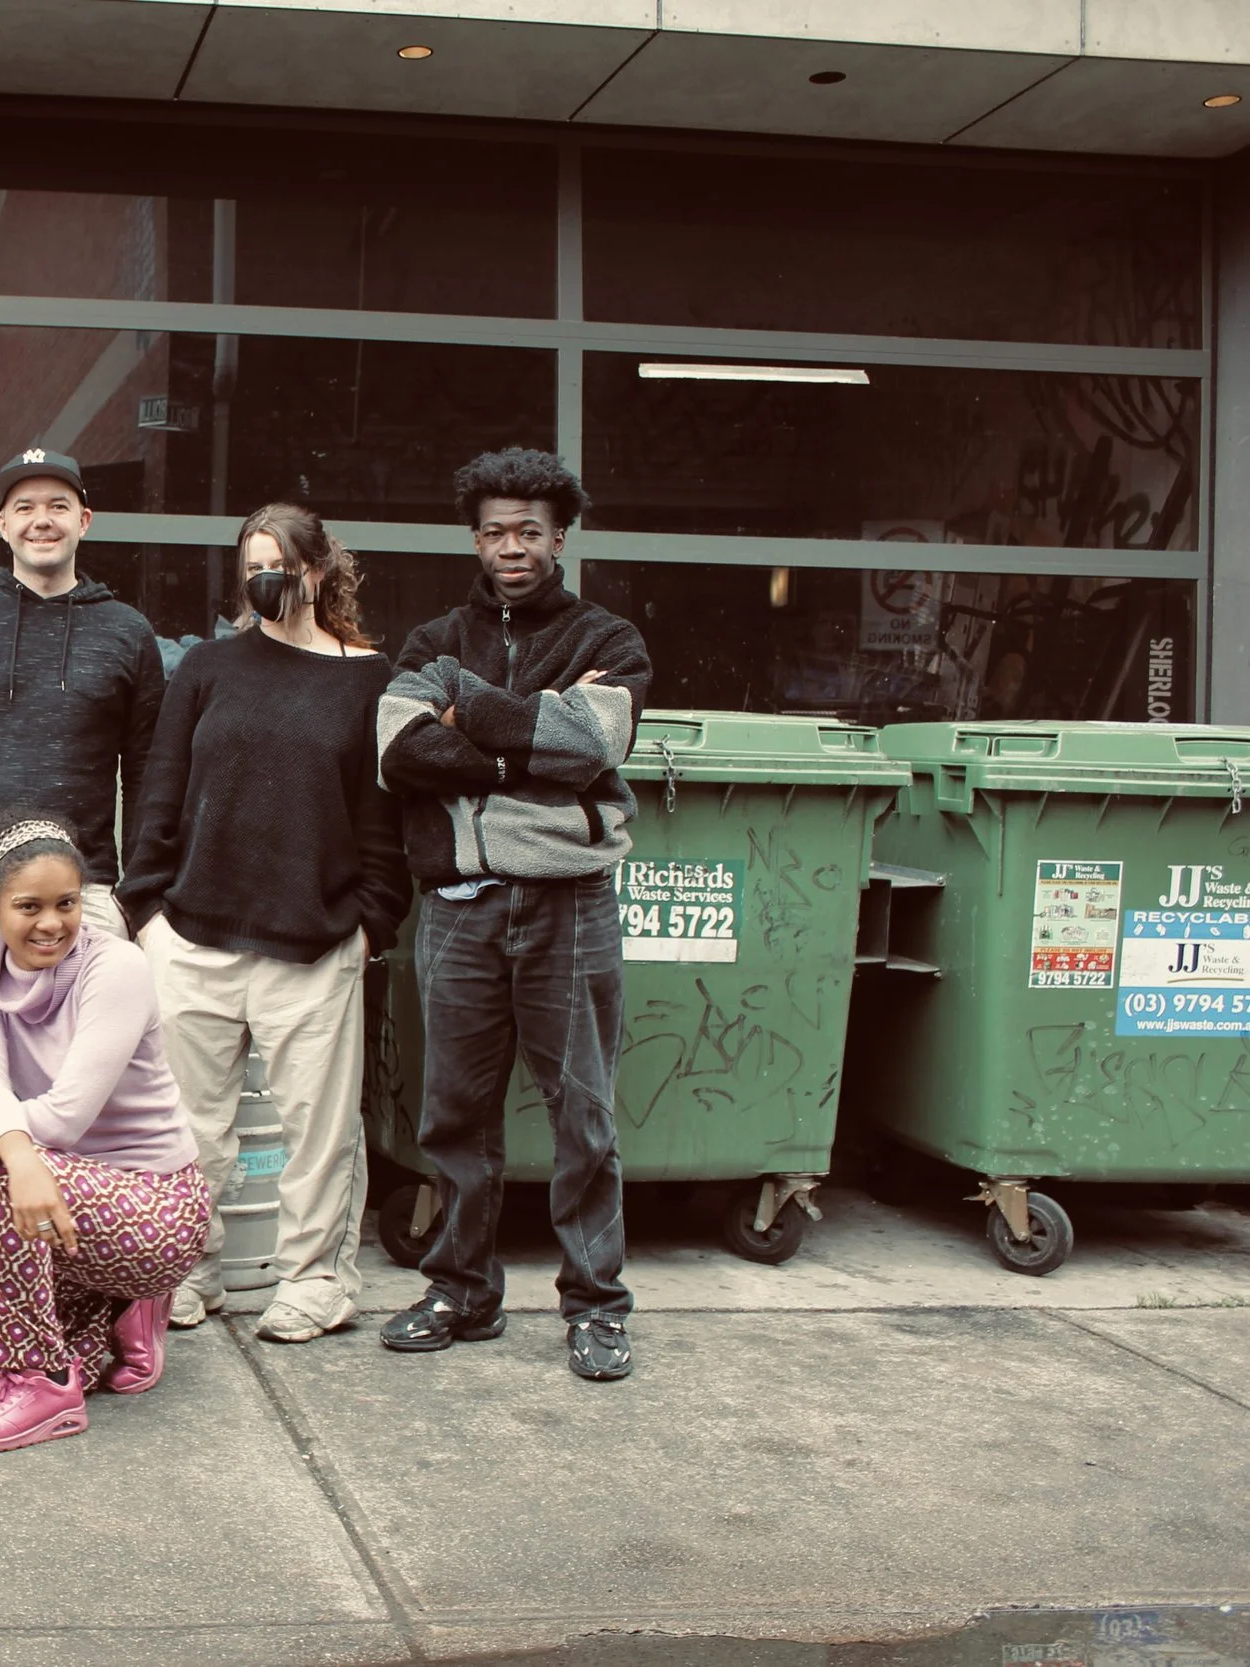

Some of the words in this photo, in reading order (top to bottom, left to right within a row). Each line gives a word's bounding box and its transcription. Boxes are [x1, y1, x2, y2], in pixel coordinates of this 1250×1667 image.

[22, 448, 46, 464] NY
[627, 861, 734, 889] Richards
[1075, 872, 1106, 881] Recycling
[627, 886, 671, 901] Waste
[673, 887, 734, 903] Services
[1204, 882, 1242, 894] Waste
[668, 905, 735, 938] 5722
[1203, 955, 1230, 964] Waste
[1232, 955, 1241, 964] &
[1202, 965, 1245, 975] Recycling
[1037, 971, 1071, 985] 9794
[1073, 971, 1106, 985] 5722
[1124, 993, 1167, 1018] (03)
[1172, 993, 1225, 1013] 9794
